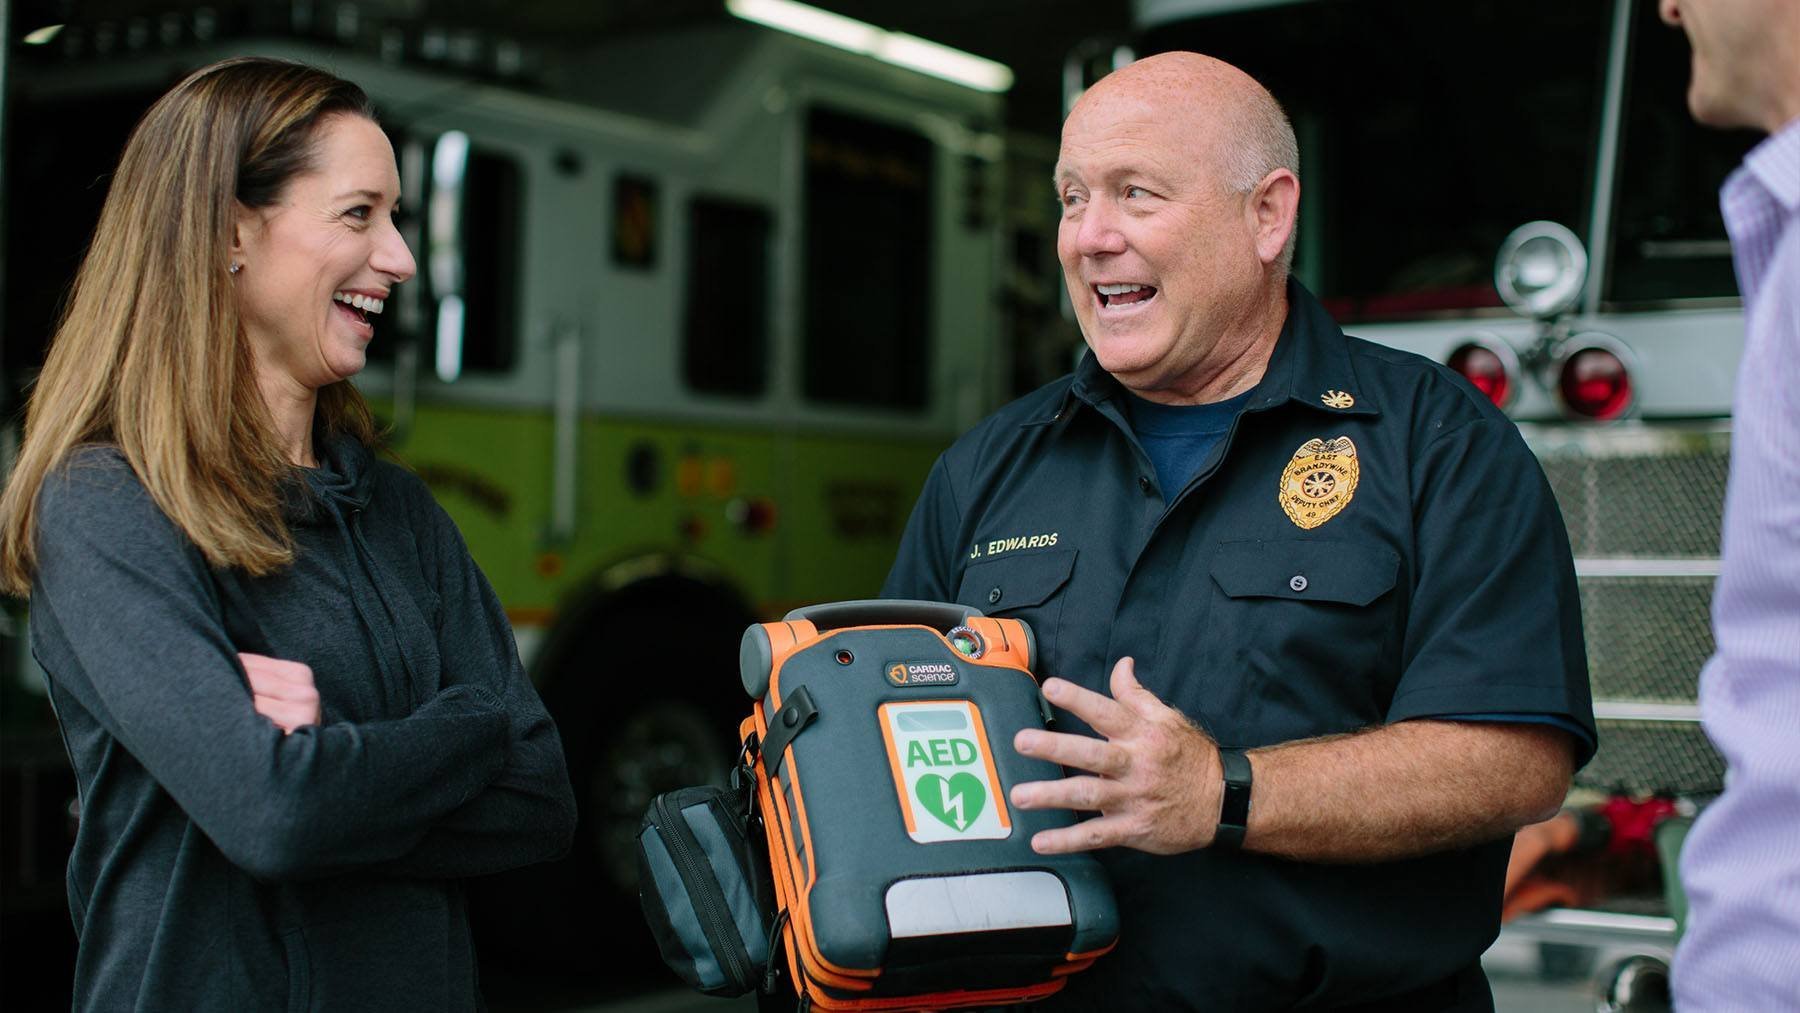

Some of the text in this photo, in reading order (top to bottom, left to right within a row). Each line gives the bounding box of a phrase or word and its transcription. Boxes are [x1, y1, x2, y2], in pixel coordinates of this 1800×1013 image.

[1294, 462, 1348, 476] BRANDYWINE
[1291, 494, 1340, 509] DEPUTY CHIEF
[970, 532, 1059, 559] J. EDWARDS
[909, 664, 952, 674] CARDIAC
[907, 738, 978, 768] AED
